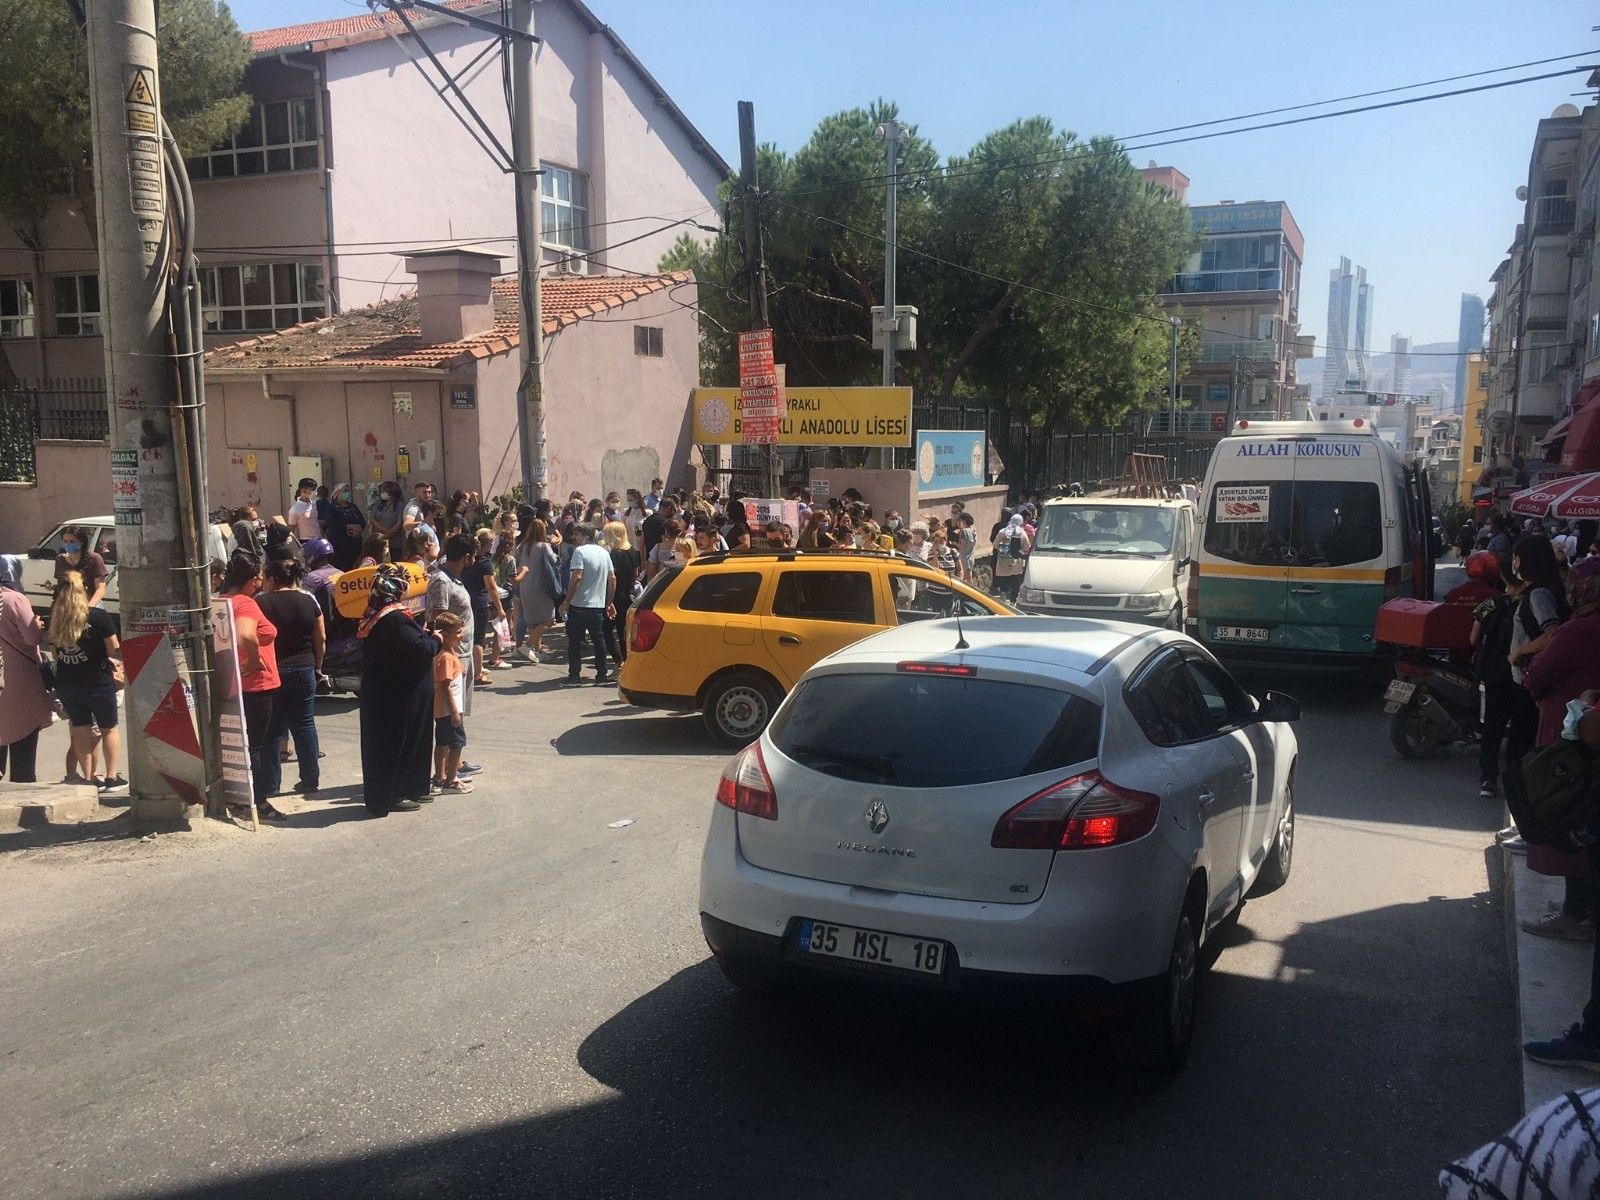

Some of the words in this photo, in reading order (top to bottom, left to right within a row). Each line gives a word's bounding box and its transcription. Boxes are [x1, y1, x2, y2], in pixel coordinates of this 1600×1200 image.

[786, 399, 820, 411] YRAKLI
[800, 419, 859, 435] ANADOLU
[866, 415, 907, 435] LİSESİ
[1236, 444, 1289, 457] ALLAH
[1297, 443, 1362, 457] KORUSUN
[1218, 627, 1229, 637] 35
[1246, 629, 1267, 639] 8640
[837, 840, 918, 858] MEGANE
[811, 924, 839, 952] 35
[852, 931, 893, 964] MSL
[913, 941, 940, 971] 18
